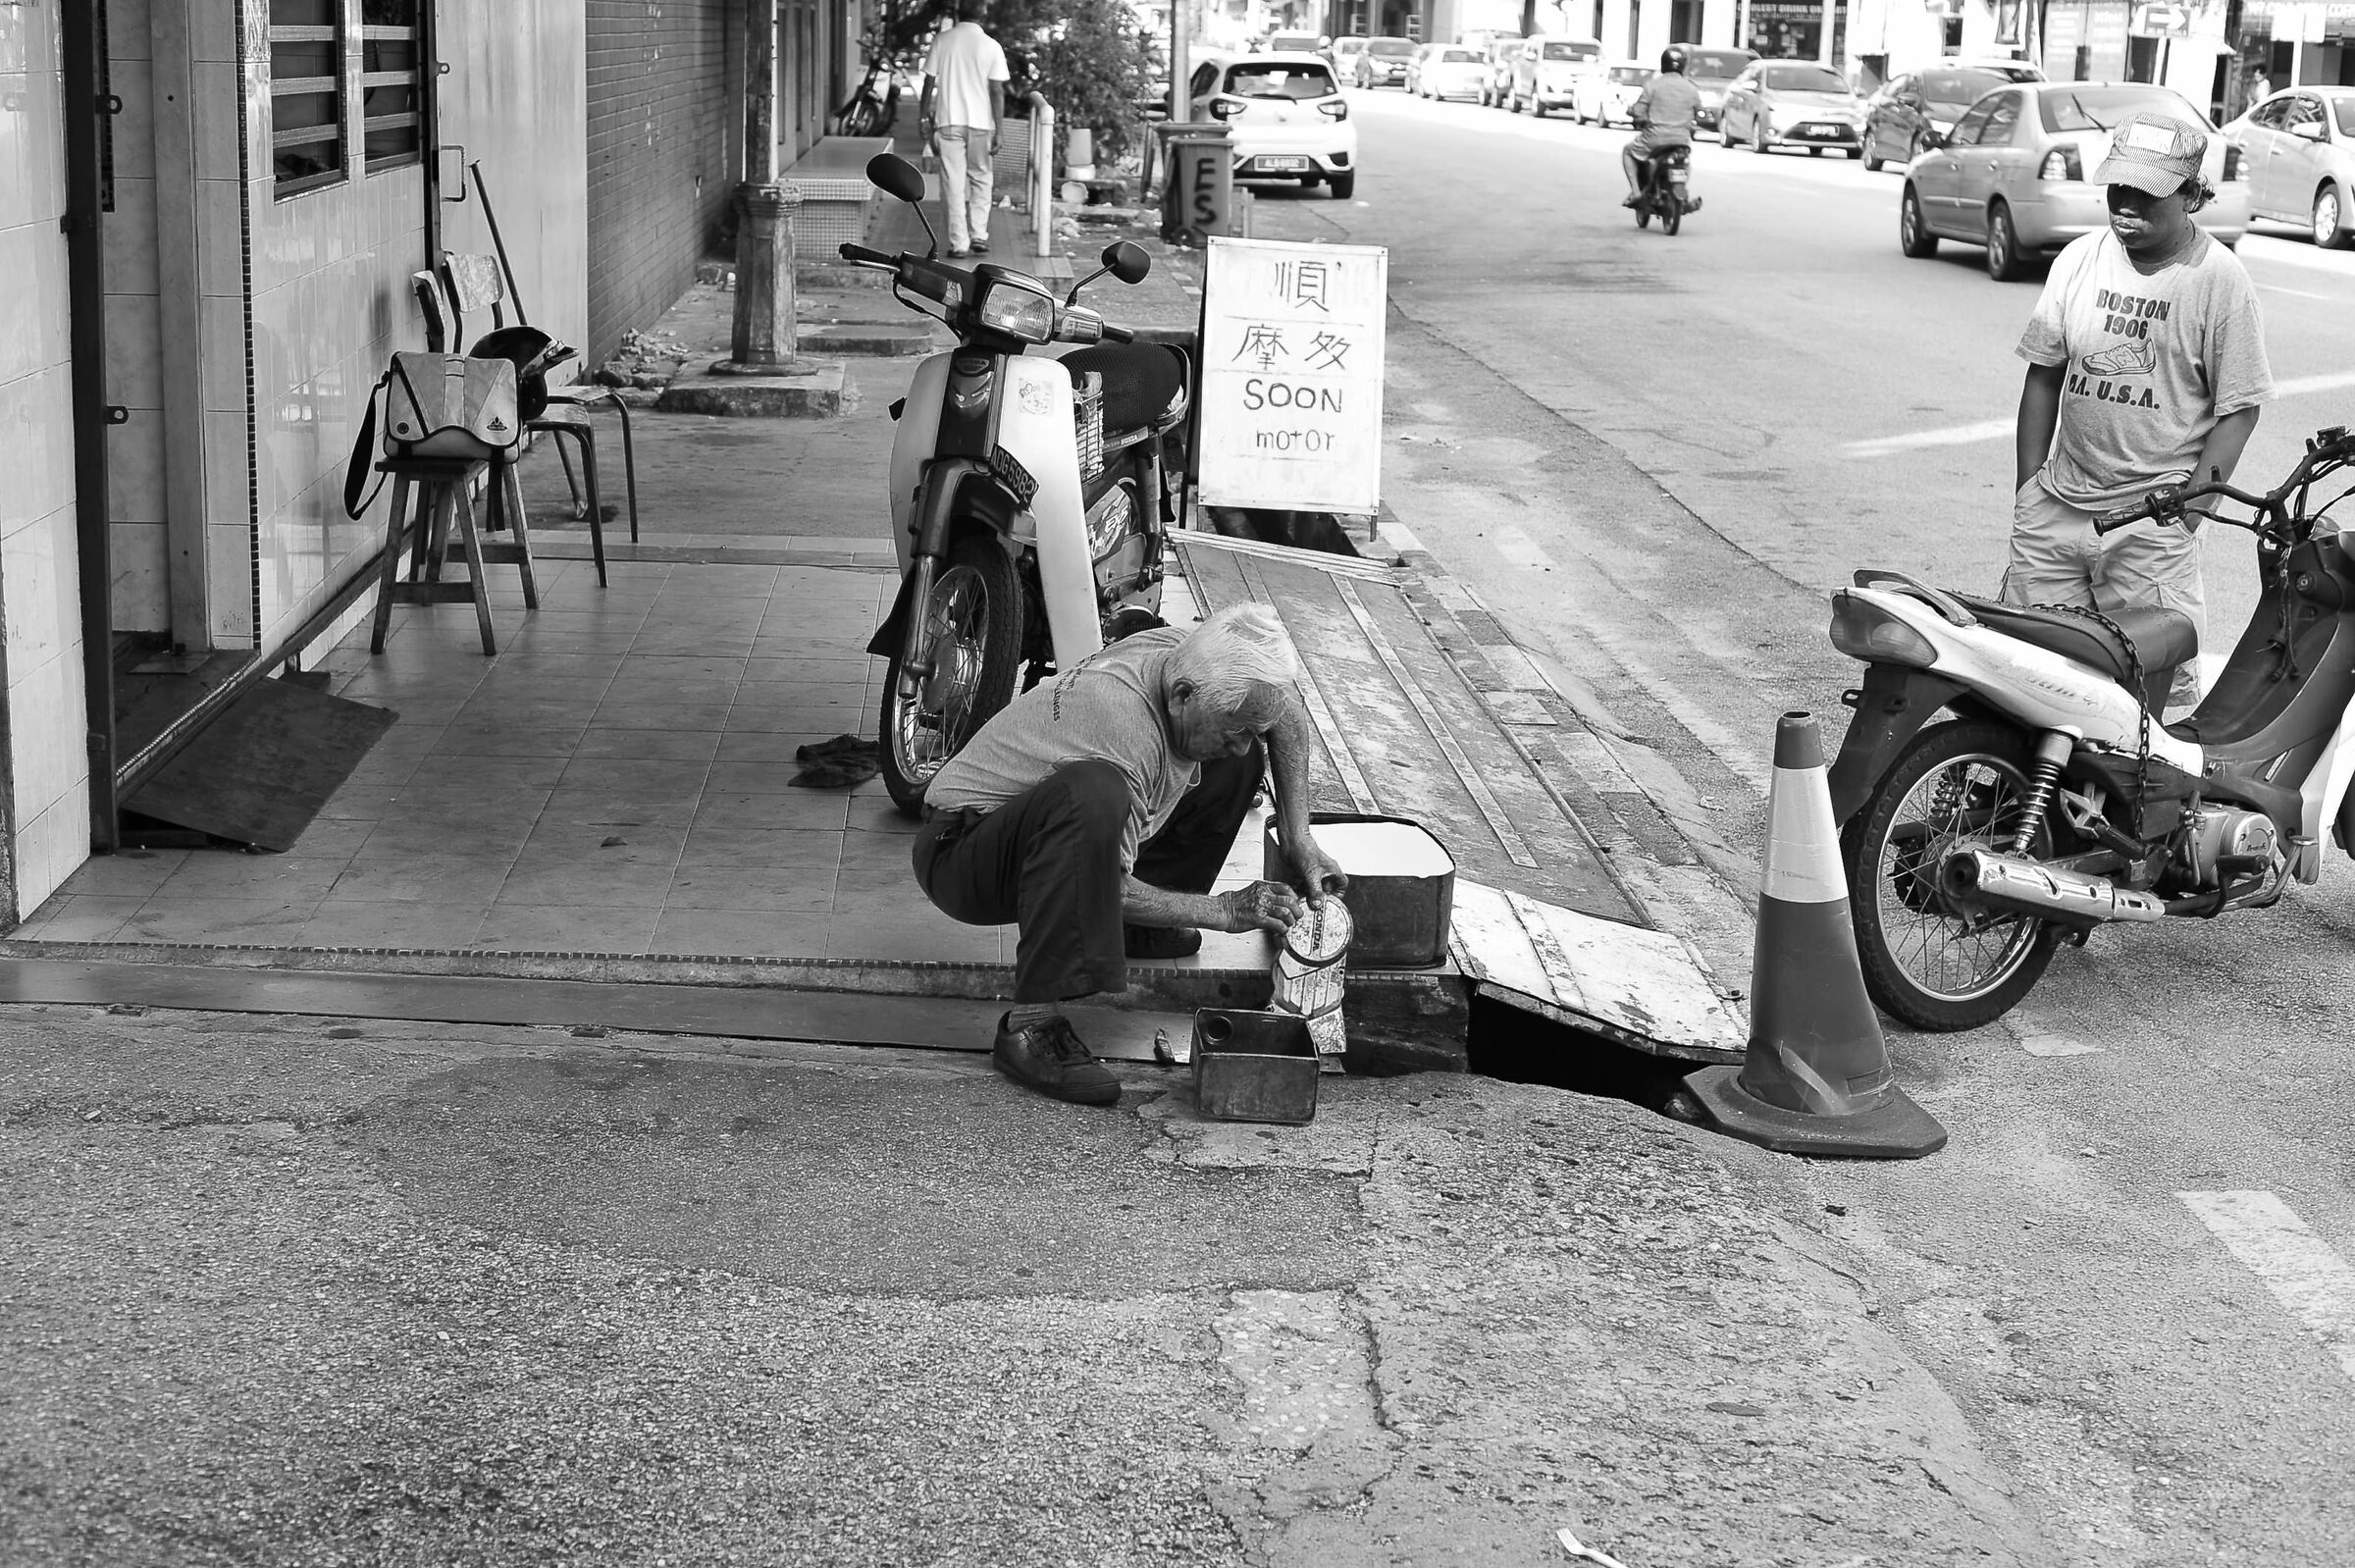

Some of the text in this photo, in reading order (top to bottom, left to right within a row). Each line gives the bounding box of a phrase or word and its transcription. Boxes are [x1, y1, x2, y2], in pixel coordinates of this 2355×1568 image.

[2096, 288, 2171, 321] BOSTON
[2104, 314, 2149, 340] 1906
[1243, 379, 1342, 413] SOON
[2097, 380, 2160, 409] U.S.A.
[1256, 429, 1335, 451] motor
